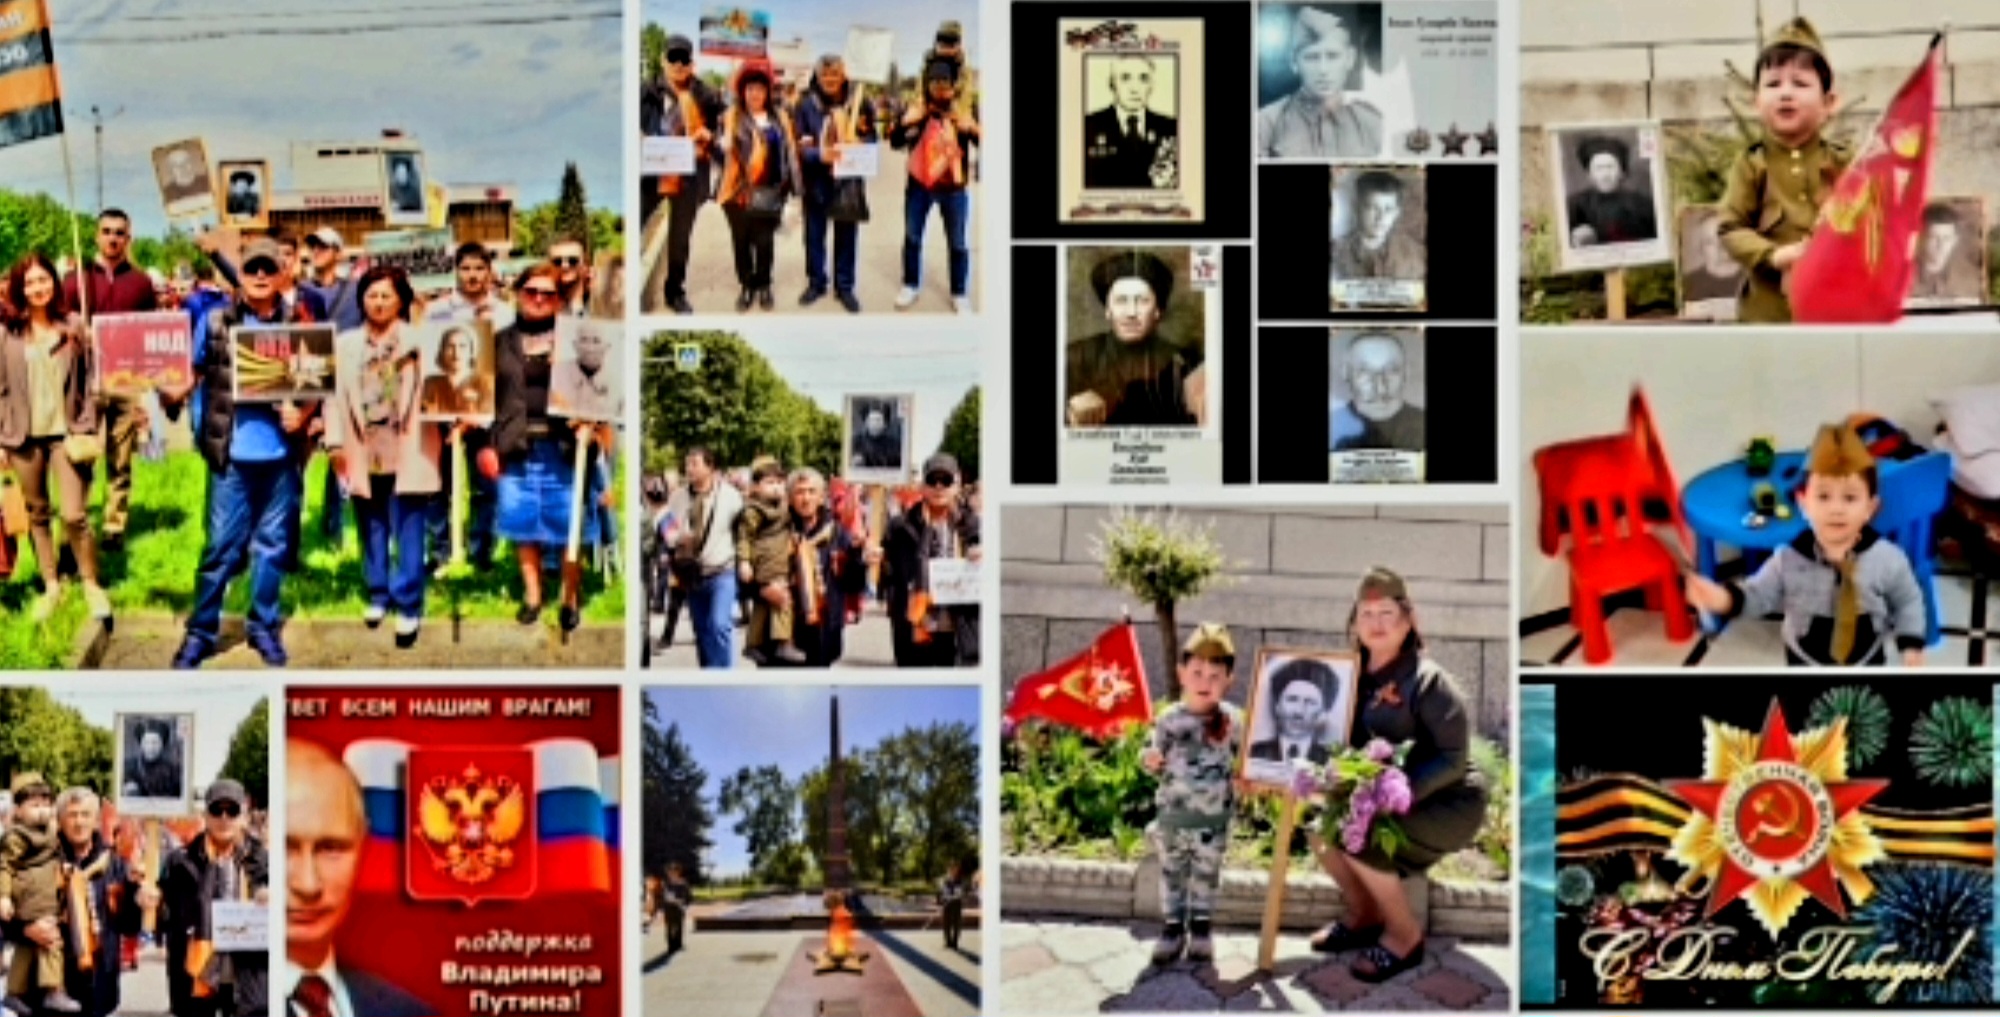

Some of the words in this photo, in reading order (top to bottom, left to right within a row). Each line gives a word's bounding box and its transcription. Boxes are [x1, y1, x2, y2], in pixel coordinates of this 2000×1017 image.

[144, 330, 186, 354] НОД
[286, 698, 327, 717] ВЕТ
[341, 698, 397, 717] ВСЕМ
[409, 698, 491, 717] НАШИМ
[502, 698, 591, 717] ВРАГАМ!
[455, 929, 592, 958] поддержка
[441, 961, 602, 987] Владимира
[1579, 926, 1652, 992] С
[1776, 925, 1976, 1004] Победы!
[469, 989, 581, 1016] Путина!
